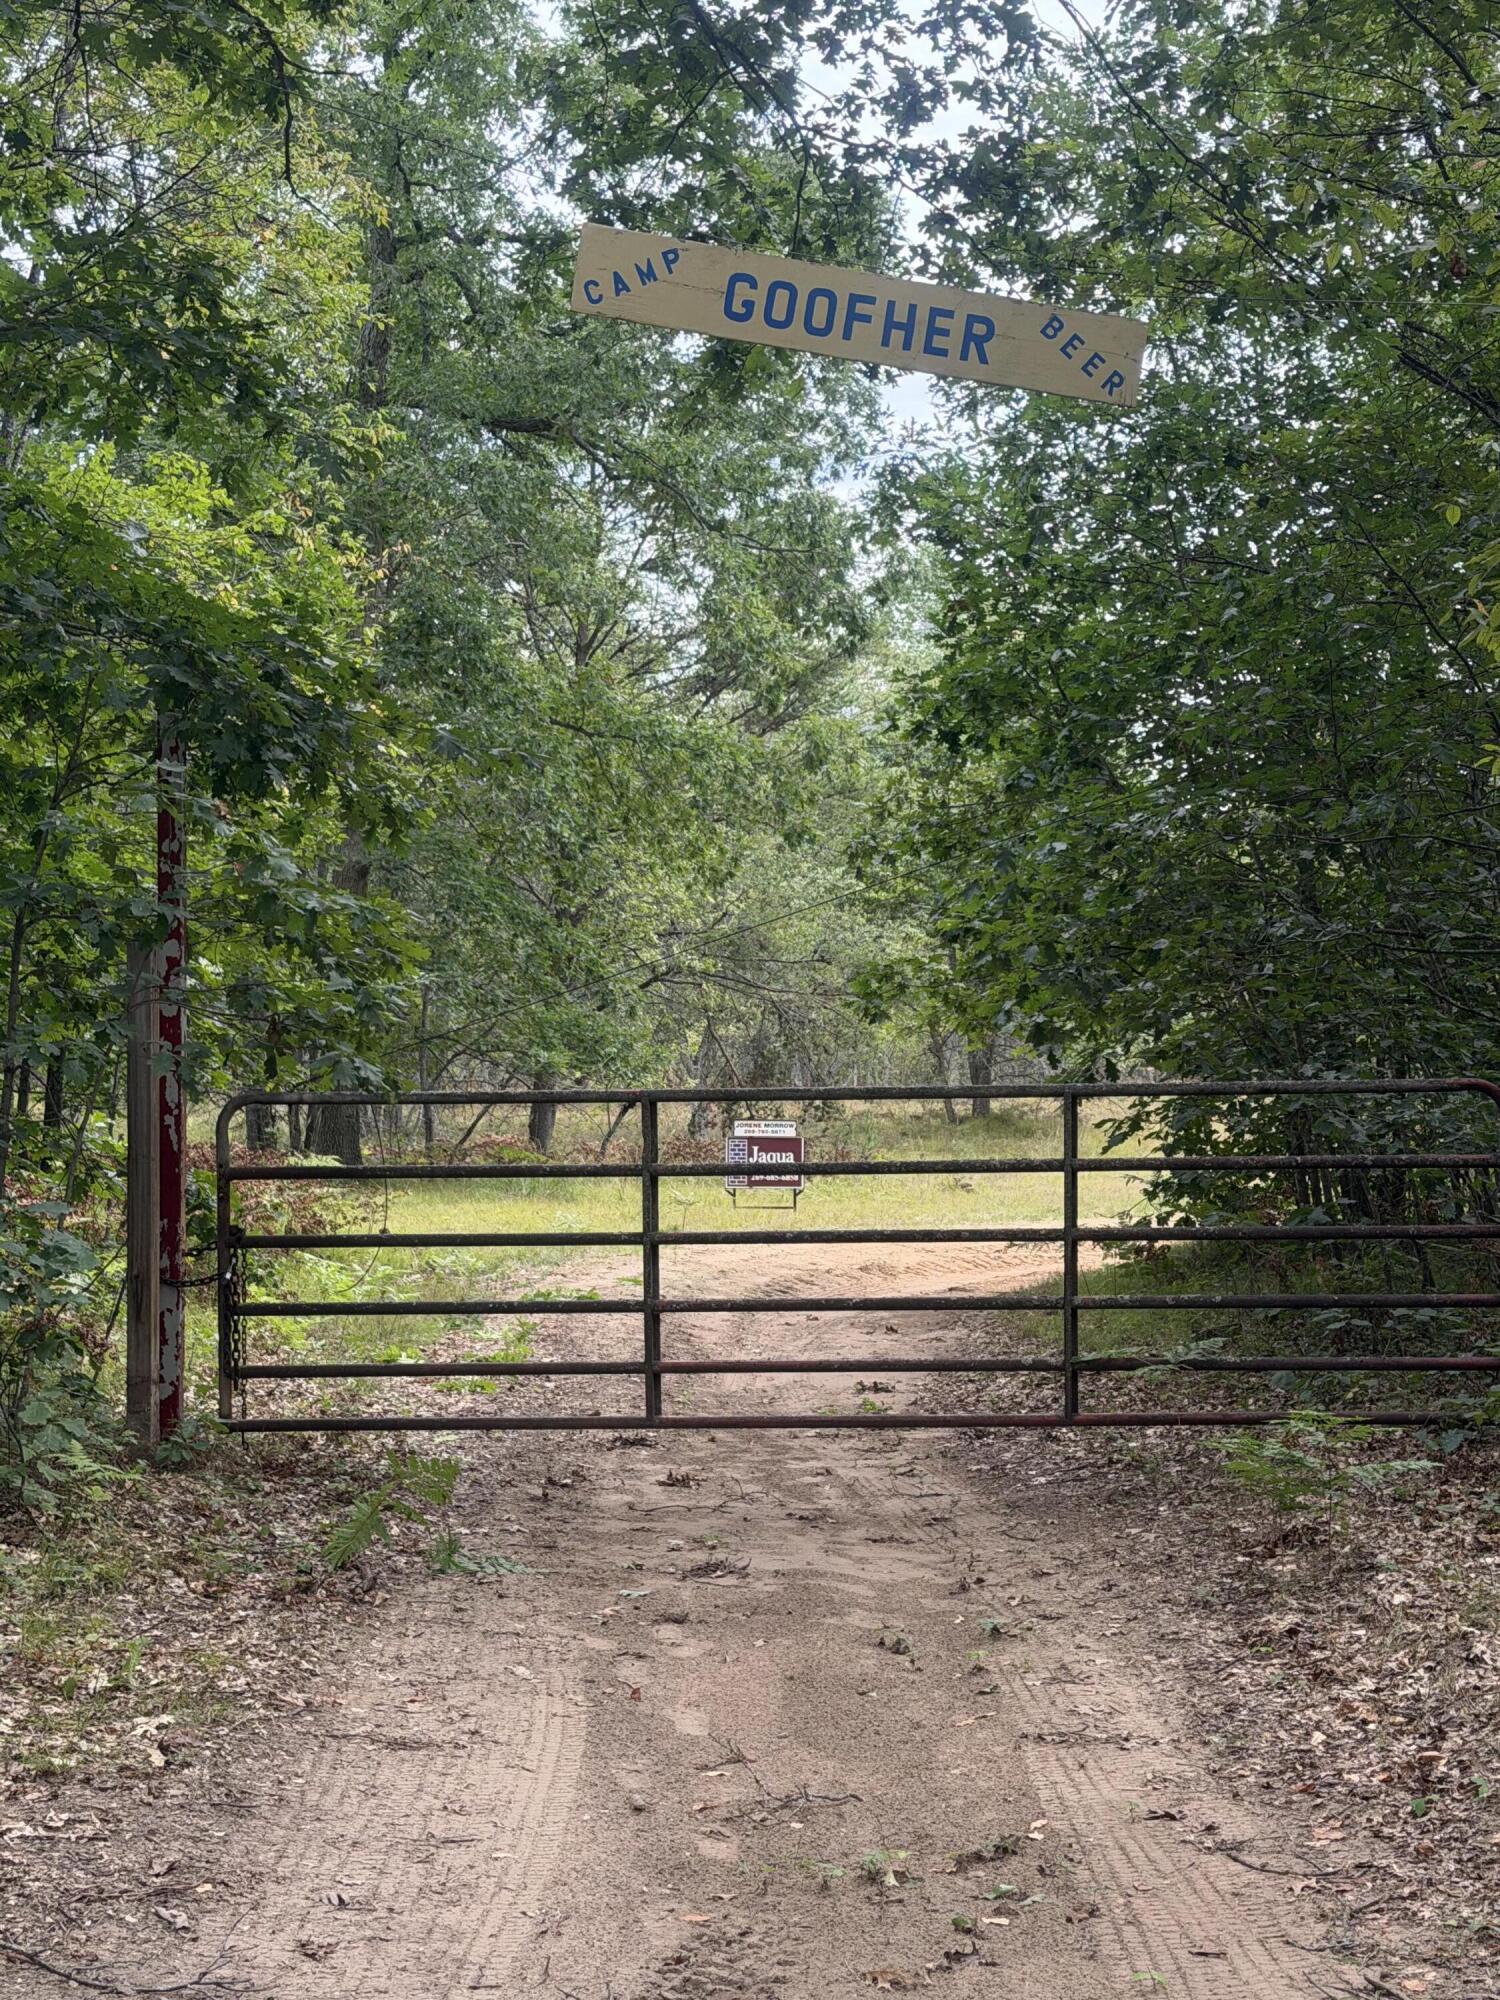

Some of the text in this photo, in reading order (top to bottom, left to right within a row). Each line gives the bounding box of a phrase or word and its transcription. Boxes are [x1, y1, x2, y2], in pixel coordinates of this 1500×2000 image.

[583, 247, 1125, 397] CAMP GOOFHER BEER
